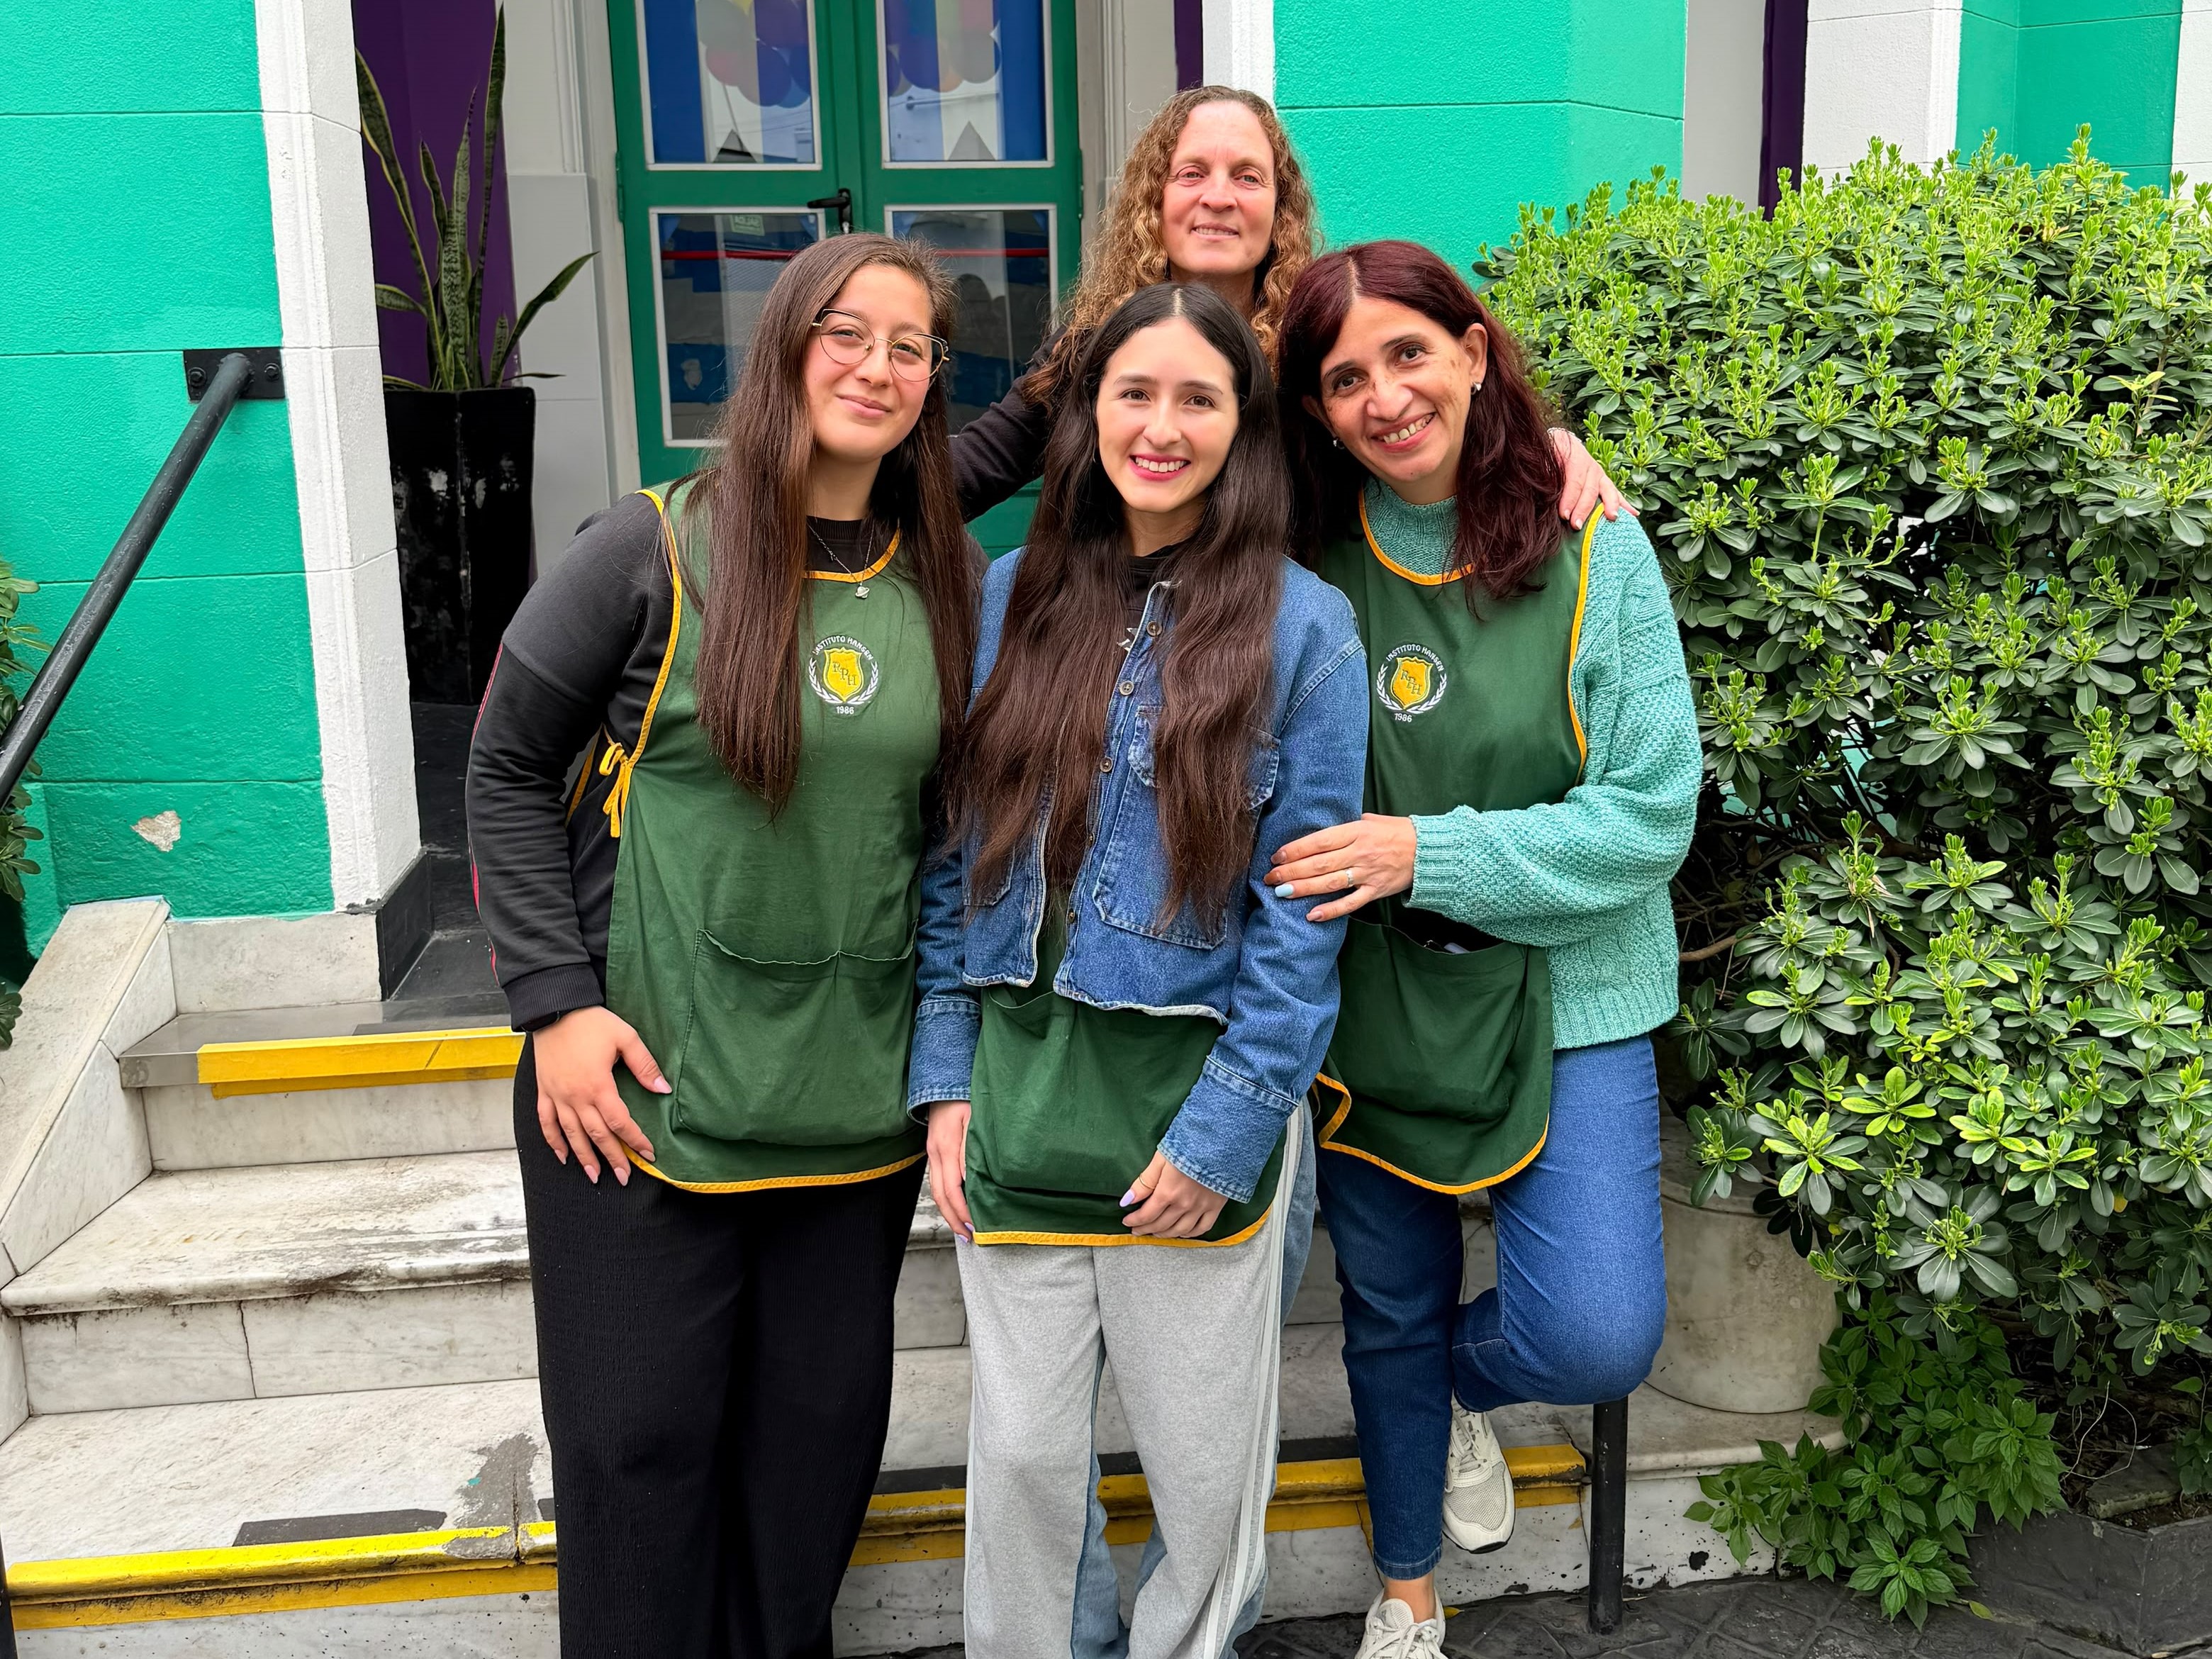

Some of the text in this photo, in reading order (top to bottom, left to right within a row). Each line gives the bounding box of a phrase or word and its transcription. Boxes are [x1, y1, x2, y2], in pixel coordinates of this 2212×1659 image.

[812, 635, 846, 655] INSTITUTO
[1385, 644, 1445, 672] INSTITUTO HANSEN
[836, 705, 854, 715] 1986
[1394, 713, 1412, 722] 1986
